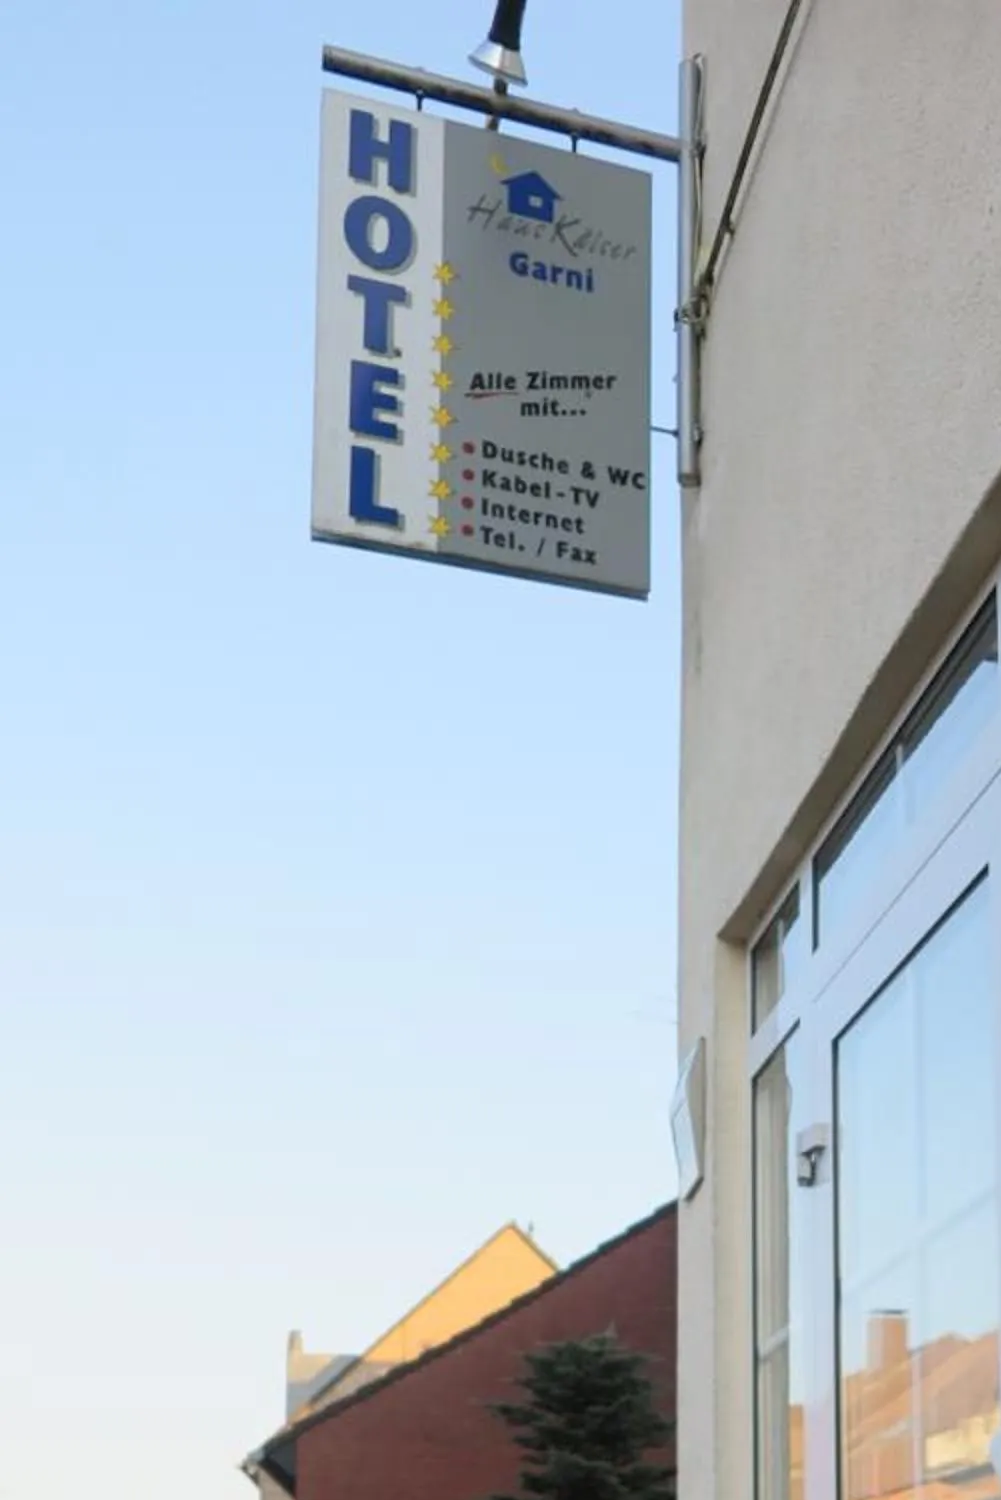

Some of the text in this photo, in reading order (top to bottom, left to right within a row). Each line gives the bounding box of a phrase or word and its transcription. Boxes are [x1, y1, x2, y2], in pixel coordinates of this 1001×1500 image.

[509, 249, 595, 293] Garni
[343, 109, 416, 530] HOTEL
[469, 371, 618, 391] Alle Zimmer
[520, 398, 587, 417] mit...
[481, 441, 647, 490] Dusche & WC
[480, 498, 586, 535] Internet
[480, 526, 599, 566] Tel. / Fax
